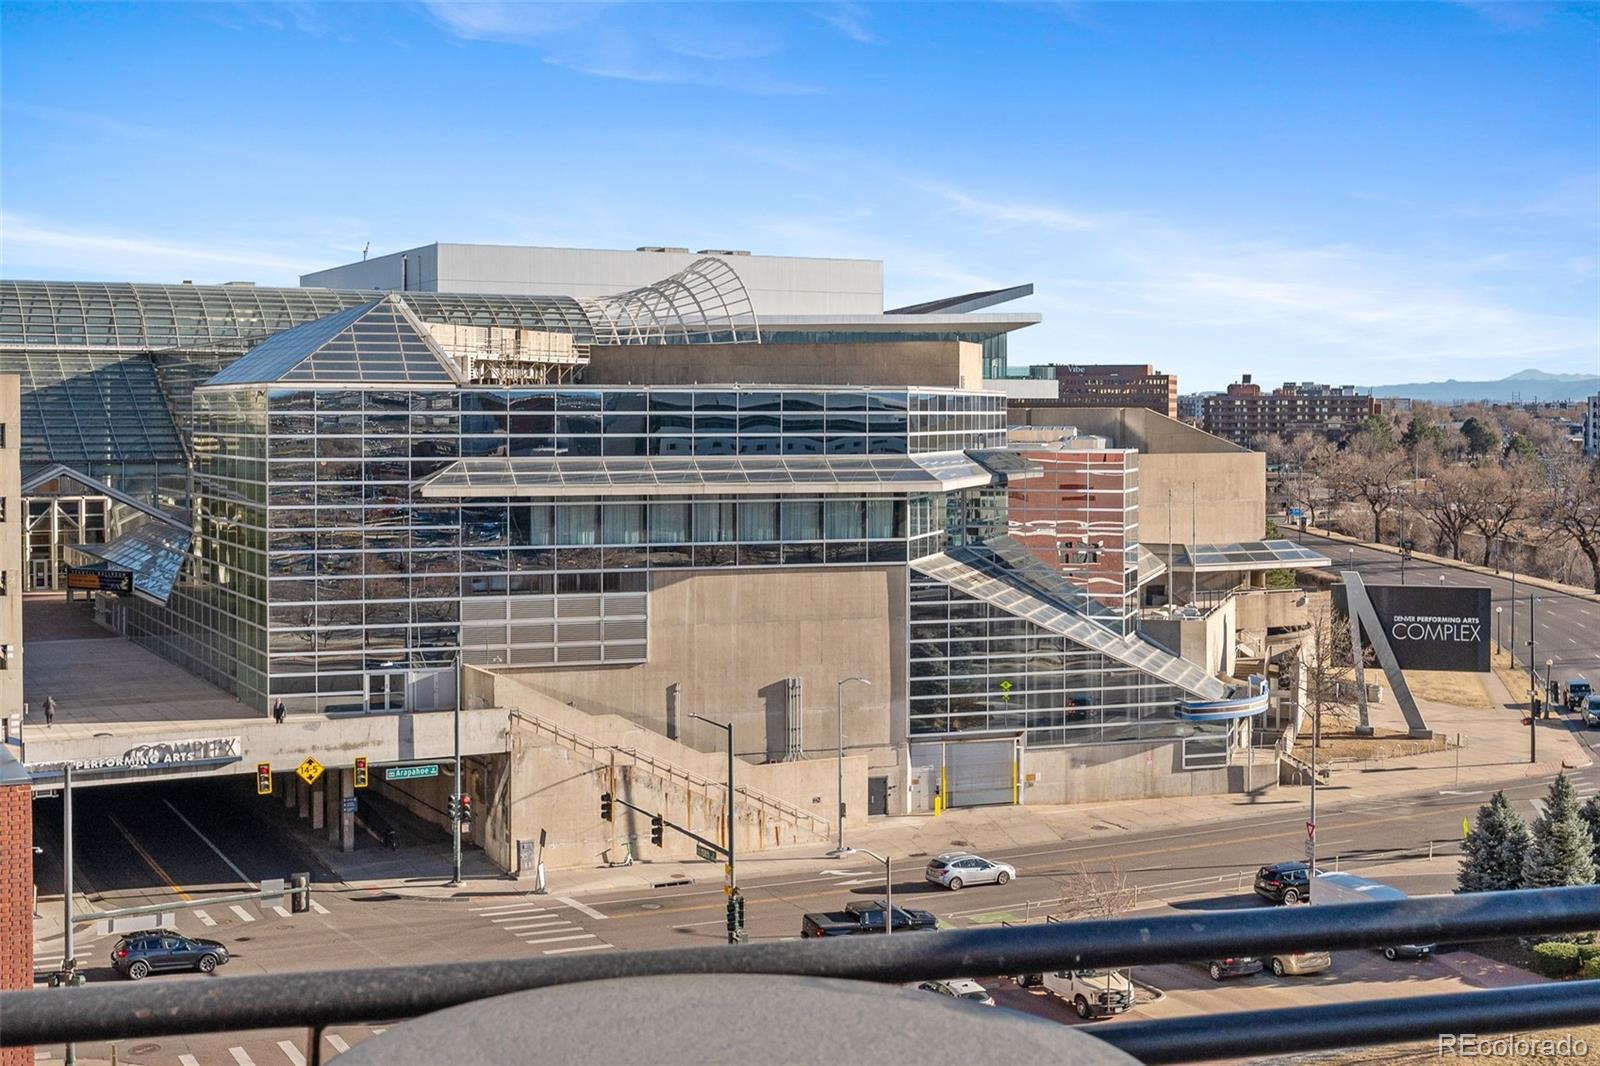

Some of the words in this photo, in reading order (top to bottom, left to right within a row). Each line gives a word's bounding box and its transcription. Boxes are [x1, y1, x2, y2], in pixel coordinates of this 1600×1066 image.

[1416, 616, 1461, 624] PERFORMING
[1391, 622, 1481, 642] COMPLEX
[75, 754, 160, 770] PERFORMING
[163, 751, 195, 763] ARTS
[395, 767, 429, 778] Arapahoe
